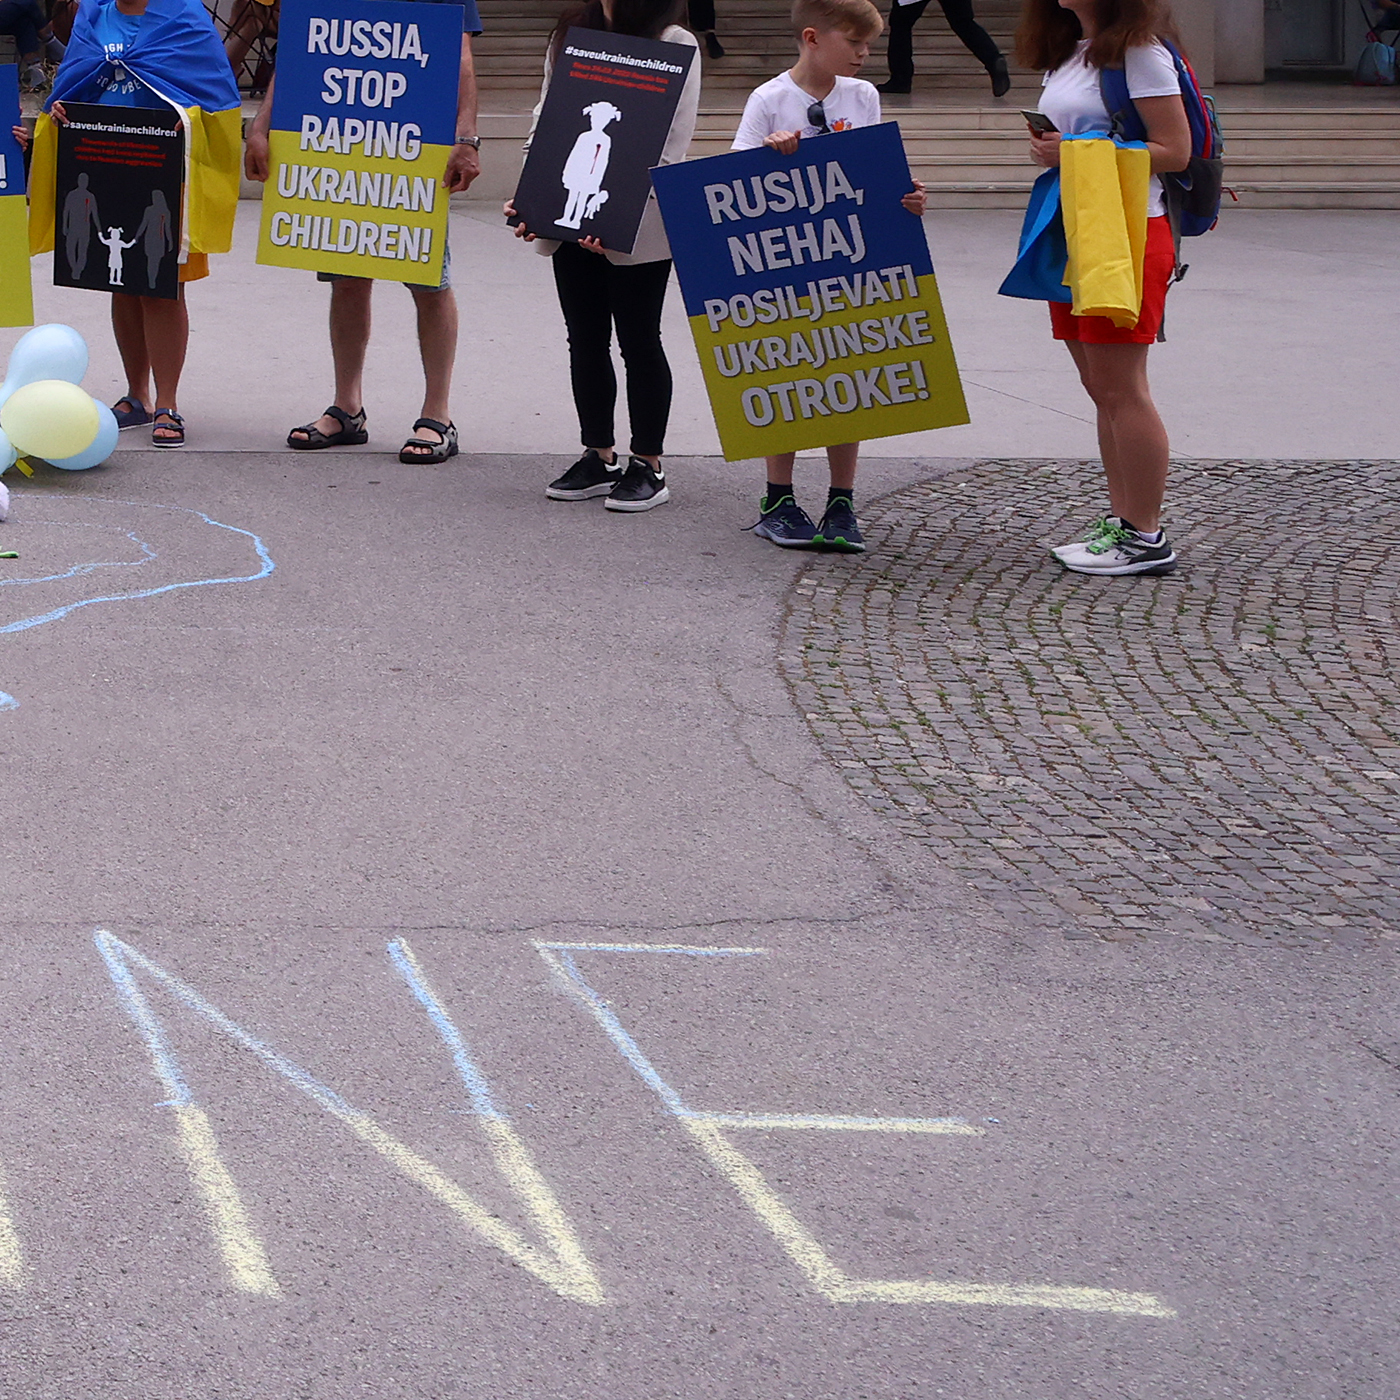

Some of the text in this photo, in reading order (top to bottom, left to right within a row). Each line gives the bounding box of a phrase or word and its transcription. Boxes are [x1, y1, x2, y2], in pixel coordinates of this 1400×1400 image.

[307, 18, 429, 68] RUSSIA,
[564, 45, 683, 75] #saveukrainianchildren
[321, 67, 407, 108] STOP
[300, 114, 422, 161] RAPING
[277, 163, 435, 213] UKRANIAN
[704, 160, 864, 225] RUSIJA,
[270, 211, 432, 263] CHILDREN!
[727, 214, 866, 276] NEHAJ
[704, 264, 919, 332] POSILJEVATI
[713, 311, 933, 378] UKRAJINSKE
[741, 359, 930, 428] OTROKE!
